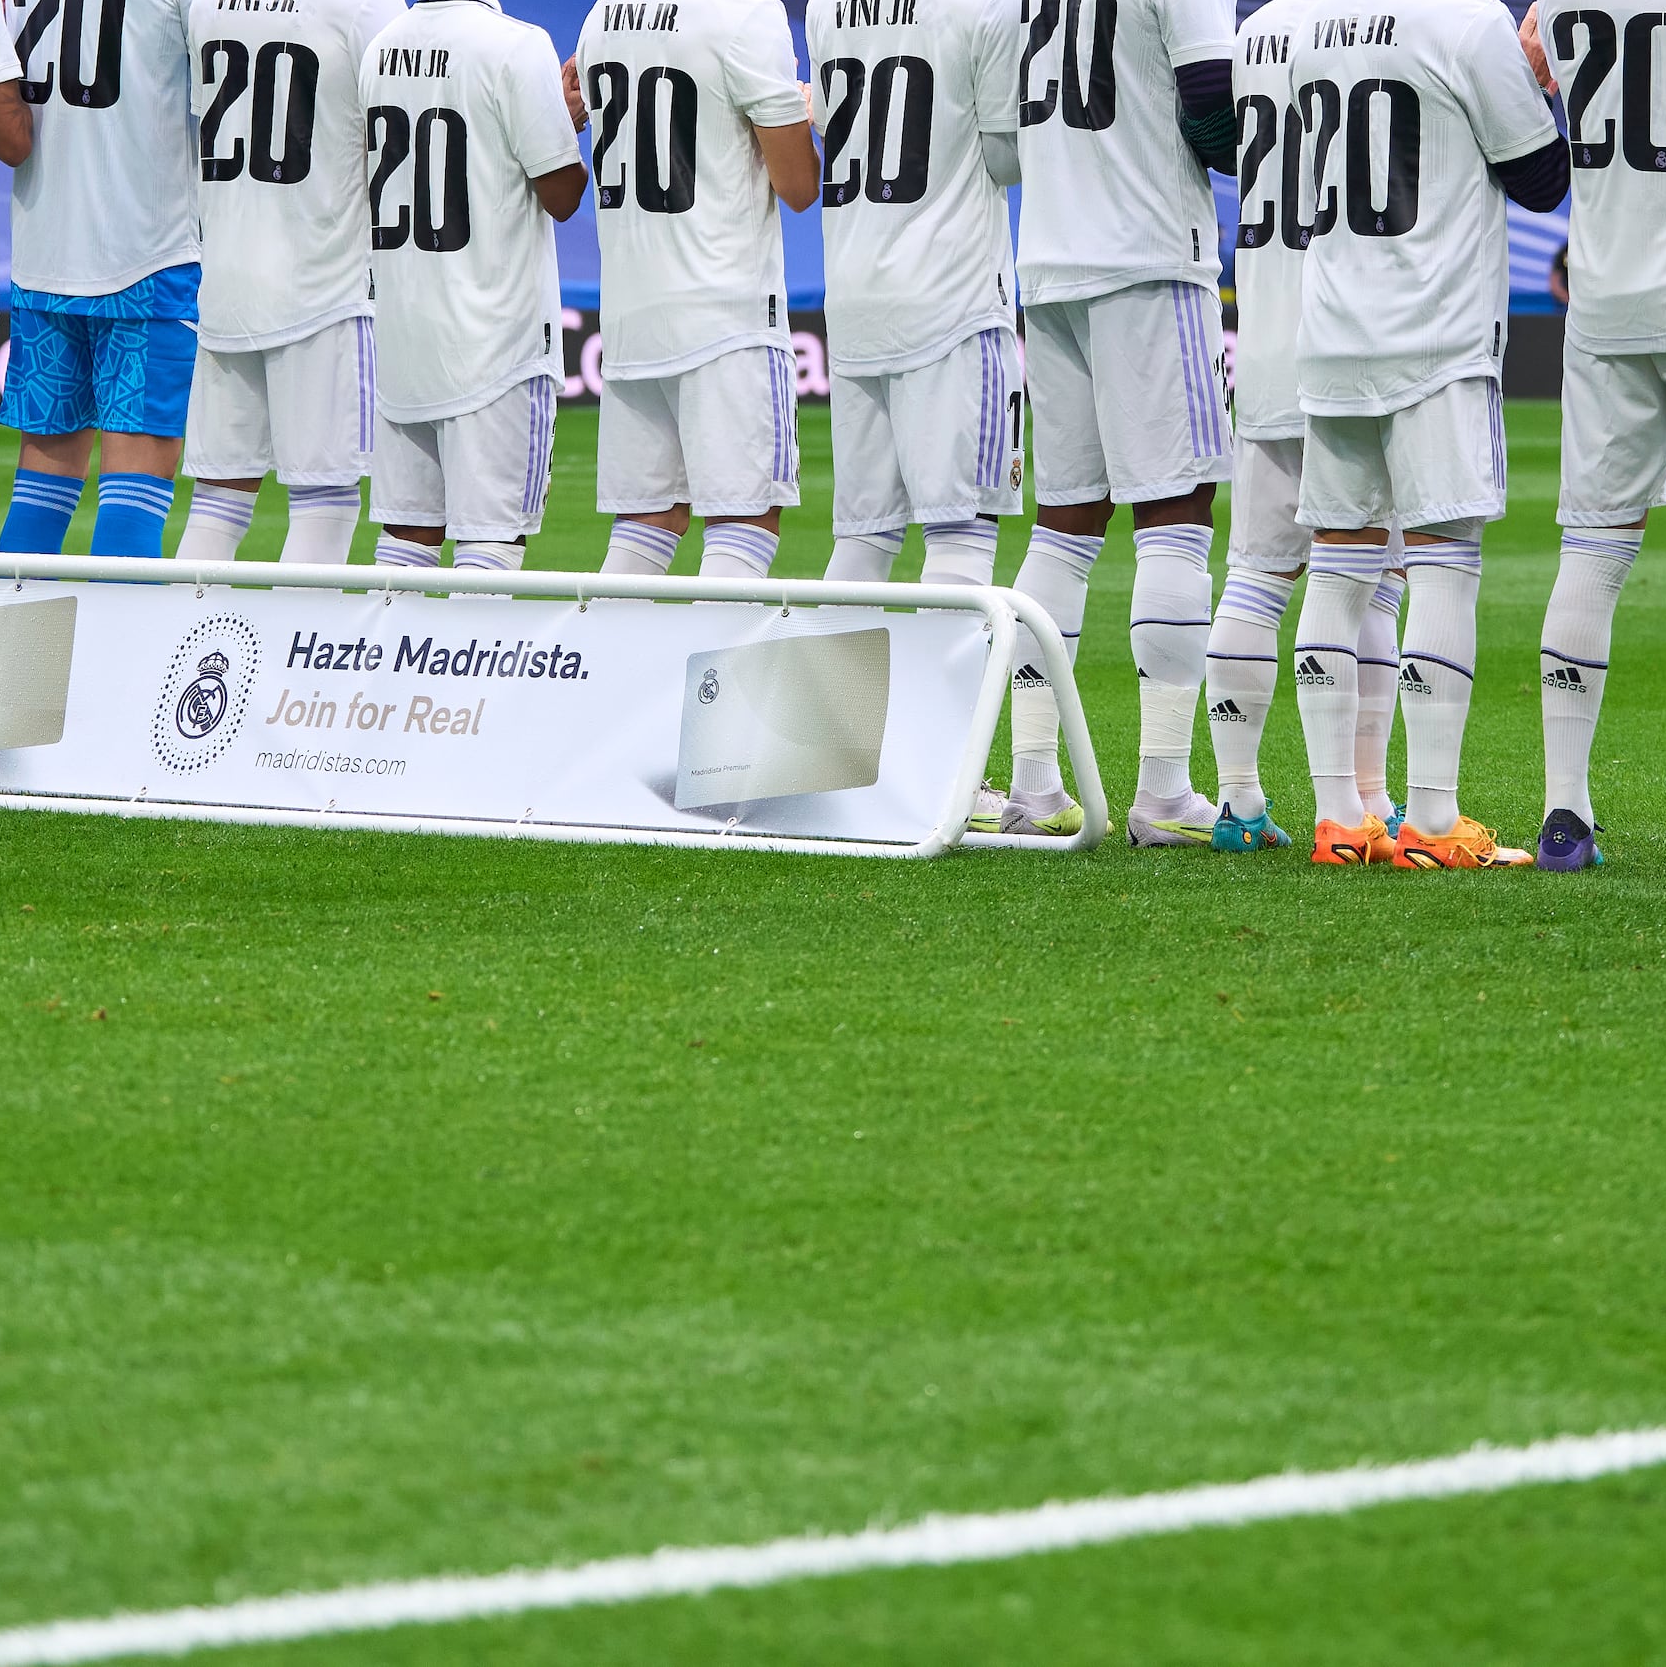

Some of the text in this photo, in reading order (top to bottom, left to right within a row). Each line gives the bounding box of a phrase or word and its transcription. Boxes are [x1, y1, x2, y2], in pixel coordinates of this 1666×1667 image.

[603, 3, 679, 33] VINI JR.
[1313, 15, 1398, 50] VINI JR.
[379, 48, 450, 79] VINI JR.
[1246, 34, 1289, 66] VINI
[201, 39, 319, 185] 20
[820, 55, 934, 208] 20
[587, 61, 698, 214] 20
[1298, 78, 1421, 237] 20
[367, 105, 470, 252] 20
[286, 630, 590, 681] Hazte Madridista.
[1542, 674, 1587, 694] adidas
[265, 688, 485, 737] Join for Real
[1208, 711, 1248, 723] adidas
[254, 748, 406, 777] madridistas.com
